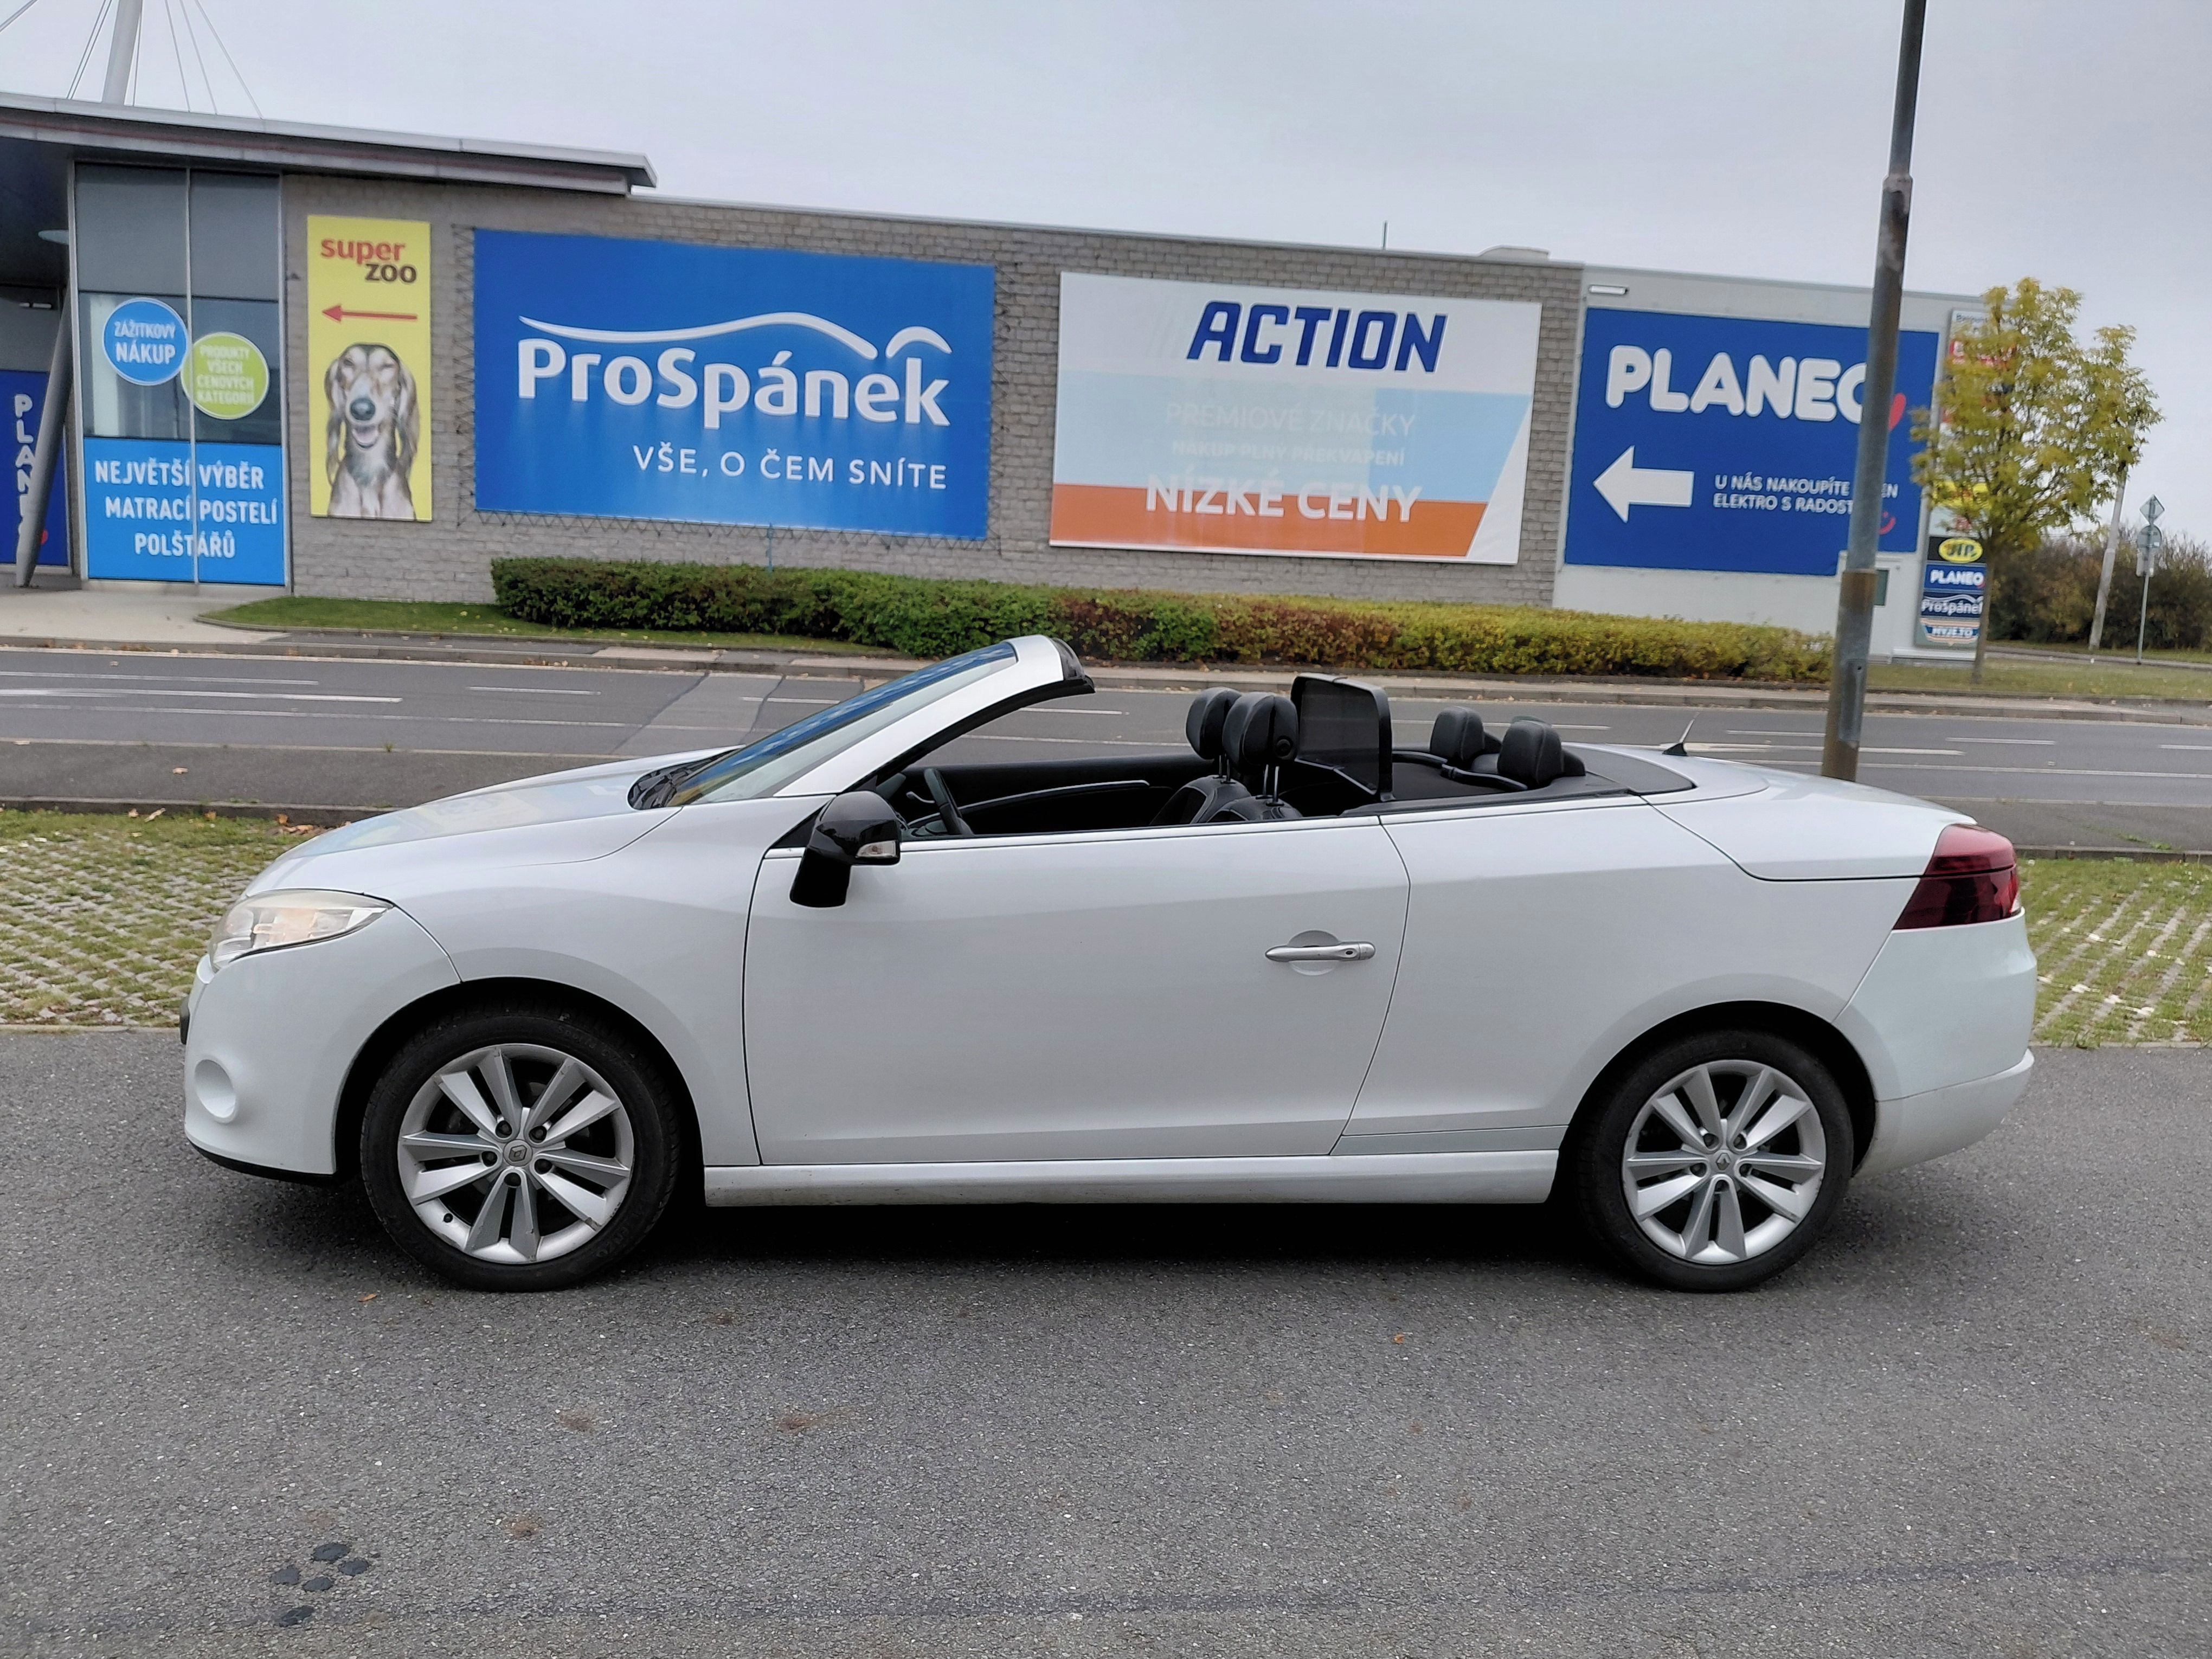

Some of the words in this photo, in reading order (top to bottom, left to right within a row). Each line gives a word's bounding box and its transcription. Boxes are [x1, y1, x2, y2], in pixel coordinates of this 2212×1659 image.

[321, 238, 406, 265] super
[365, 263, 417, 283] zoo
[1186, 300, 1449, 373] ACTION
[116, 339, 176, 365] NÁKUP
[518, 338, 951, 430] ProSpánek
[15, 393, 35, 536] PLAN
[95, 457, 191, 487] NEJVĚTŠÍ
[198, 460, 265, 490] VÝBĚR
[633, 441, 708, 478] VŠE,
[720, 451, 745, 477] O
[760, 448, 834, 482] ČEM
[849, 457, 947, 489] SNÍTE
[1146, 465, 1285, 517] NÍZKÉ
[1296, 480, 1423, 523] CENY
[1715, 474, 1727, 490] U
[1731, 472, 1763, 491] NÁS
[1766, 476, 1850, 496] NAKOUPÍTE
[105, 494, 191, 521] MATRACÍ
[200, 497, 278, 524] POSTELÍ
[1713, 493, 1778, 511] ELEKTRO
[1781, 496, 1792, 511] S
[1795, 497, 1854, 515] RADOST
[134, 529, 236, 558] POLŠTÁŘŮ
[1930, 569, 1984, 586] PLANEO
